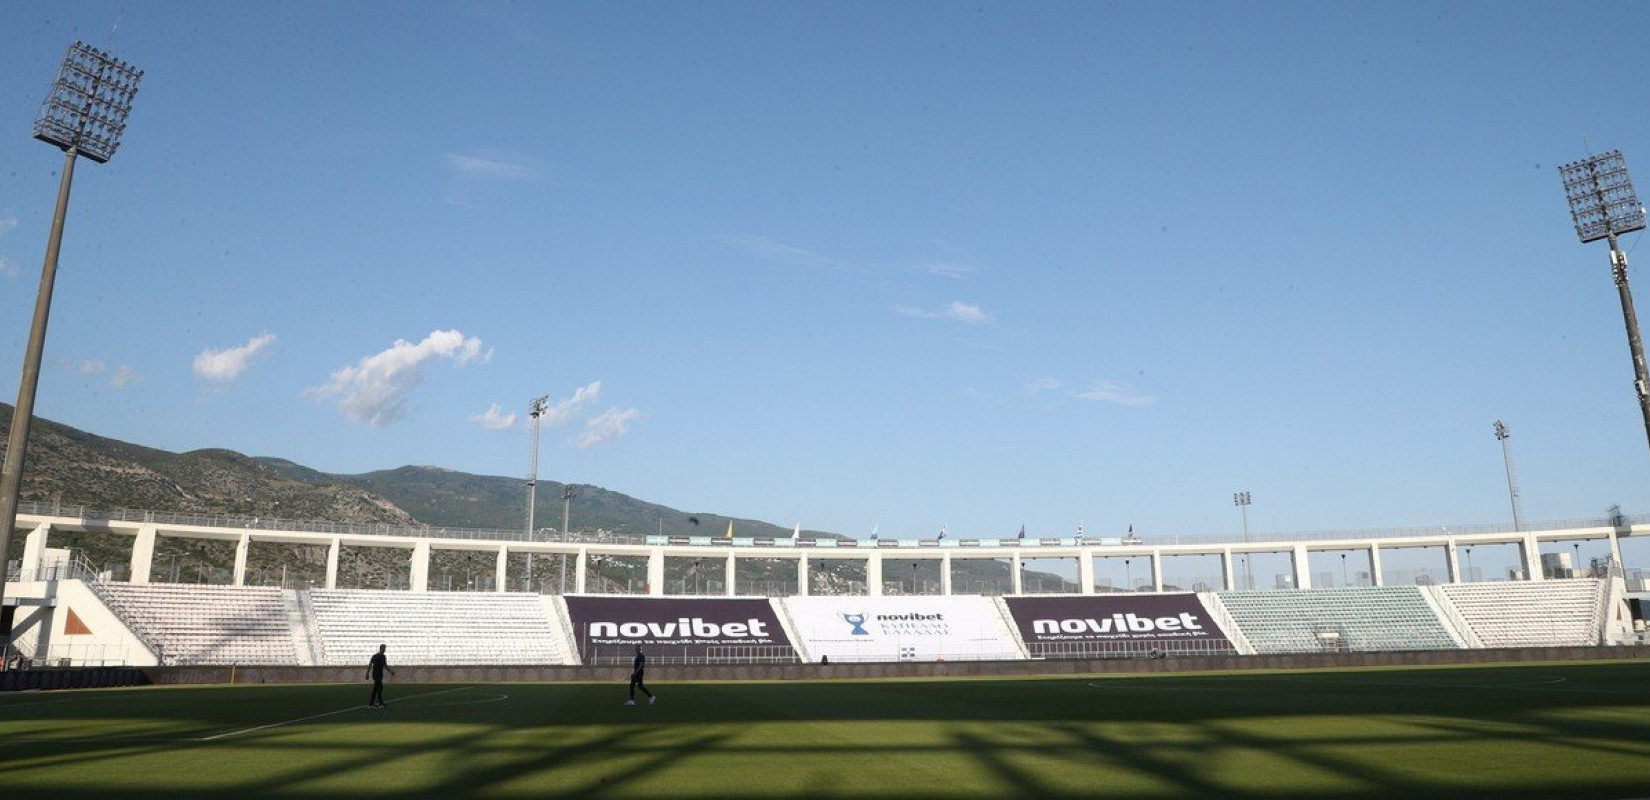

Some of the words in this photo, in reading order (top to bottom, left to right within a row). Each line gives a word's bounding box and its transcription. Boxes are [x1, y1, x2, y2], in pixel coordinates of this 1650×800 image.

[877, 612, 944, 621] novibet
[1032, 612, 1203, 634] novibet
[589, 617, 769, 637] novibet
